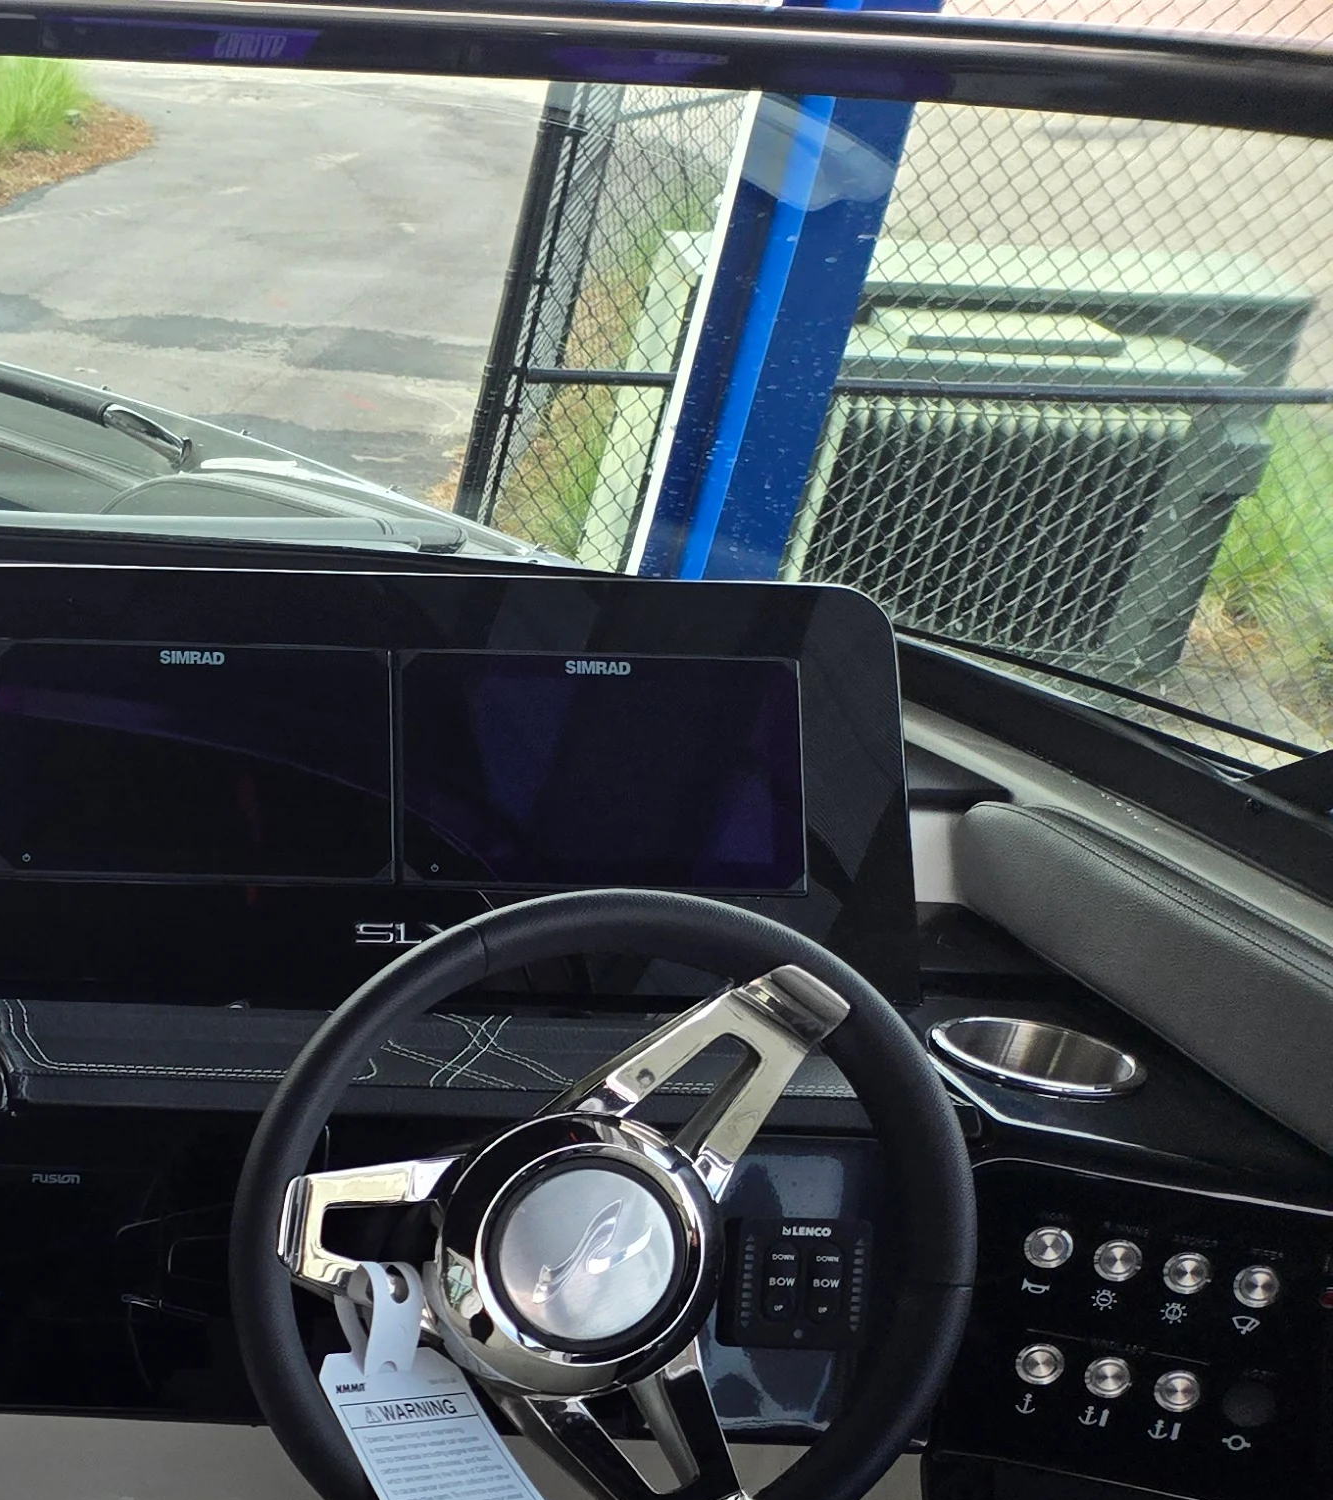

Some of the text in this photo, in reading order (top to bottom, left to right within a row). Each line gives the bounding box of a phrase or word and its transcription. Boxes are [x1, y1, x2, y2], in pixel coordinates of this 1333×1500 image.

[159, 649, 225, 665] SIMRAD
[565, 660, 631, 675] SIMRAD
[32, 1173, 81, 1184] FUSION
[791, 1226, 831, 1237] LENCO
[772, 1253, 795, 1261] DOWN
[816, 1255, 840, 1263] DOWN
[769, 1277, 795, 1287] BOW
[813, 1278, 840, 1288] BOW
[378, 1398, 458, 1422] WARNING
